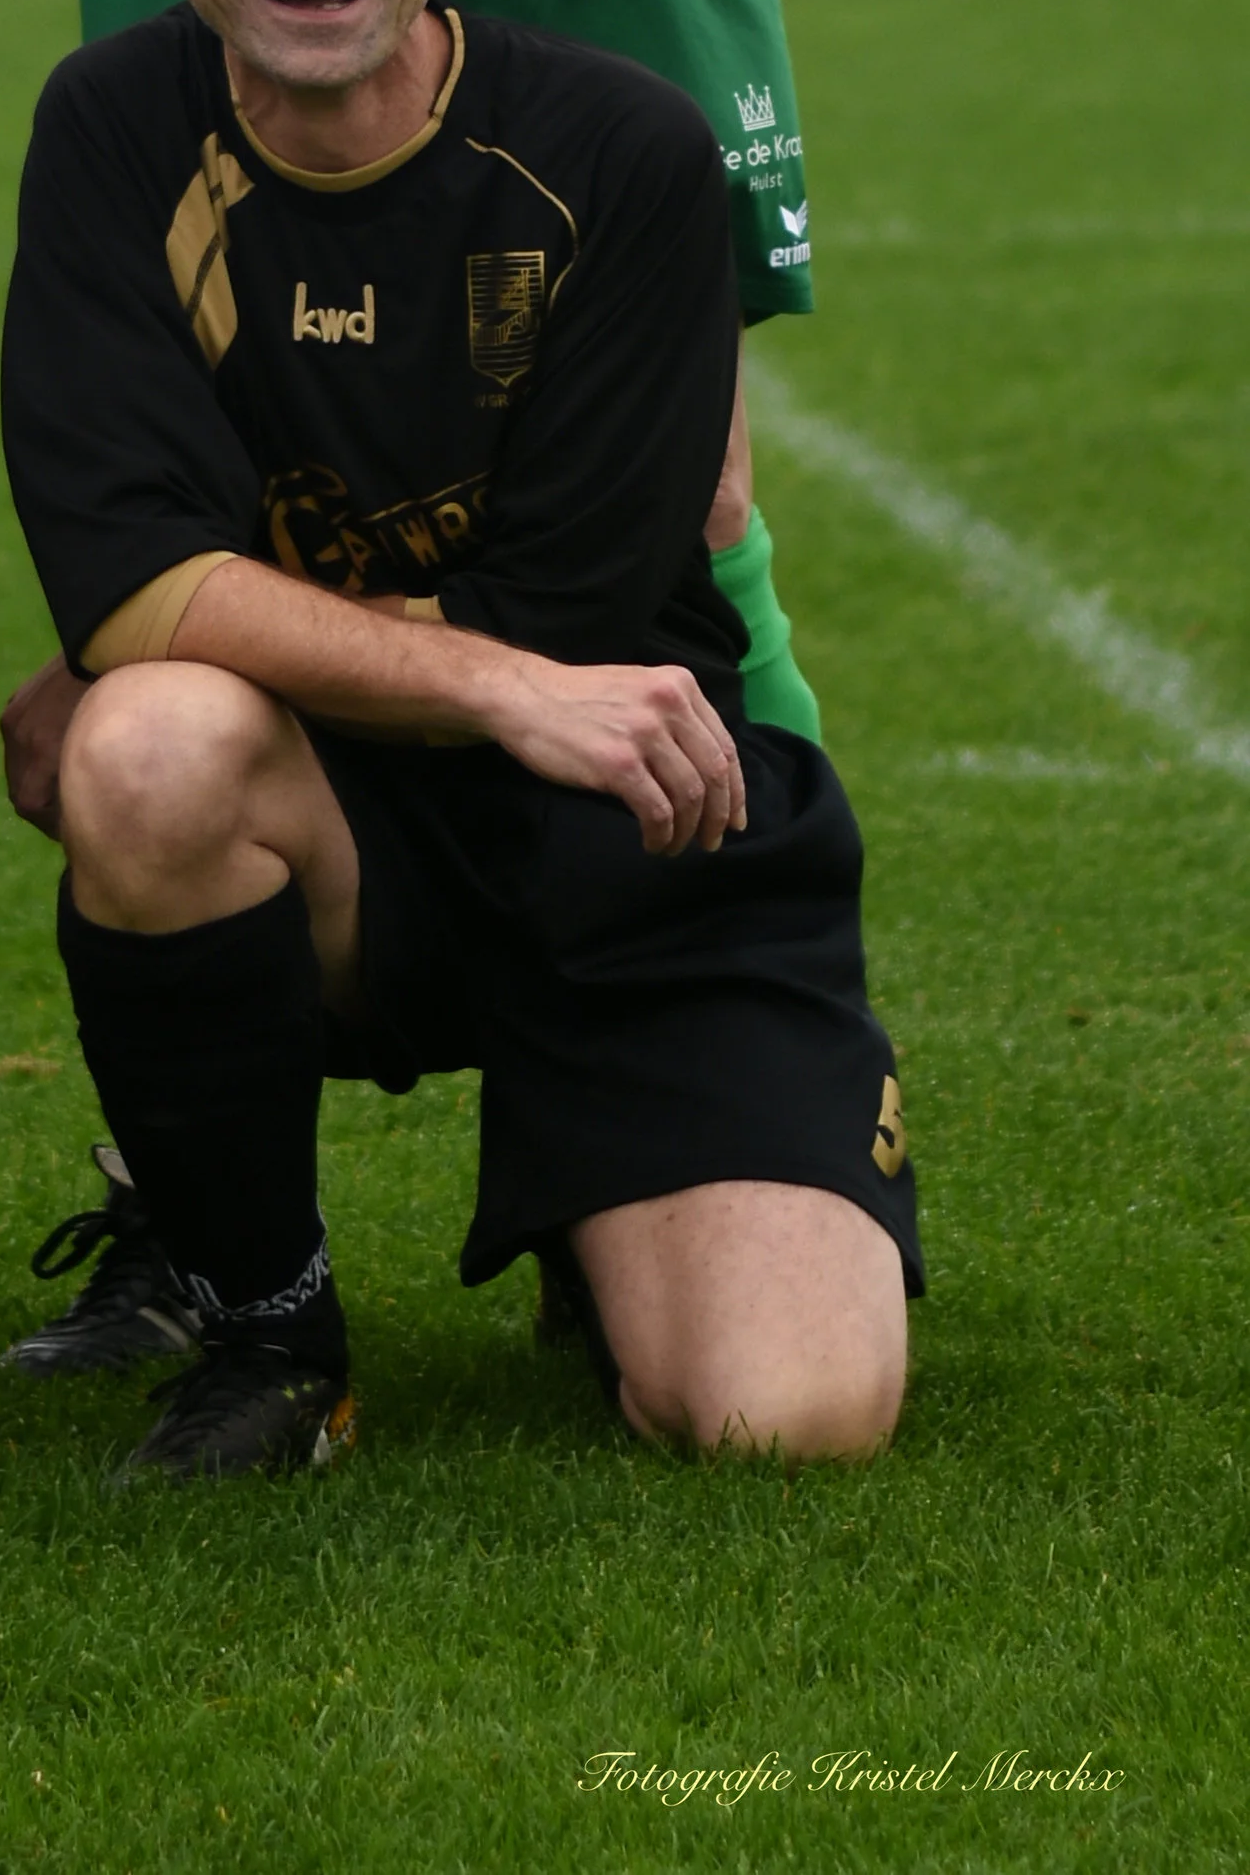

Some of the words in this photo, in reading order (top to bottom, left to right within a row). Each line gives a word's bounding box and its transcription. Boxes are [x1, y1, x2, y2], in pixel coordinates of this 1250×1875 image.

[747, 138, 772, 166] de
[750, 172, 783, 192] Hulst
[769, 241, 811, 268] erim
[292, 281, 375, 344] kwd
